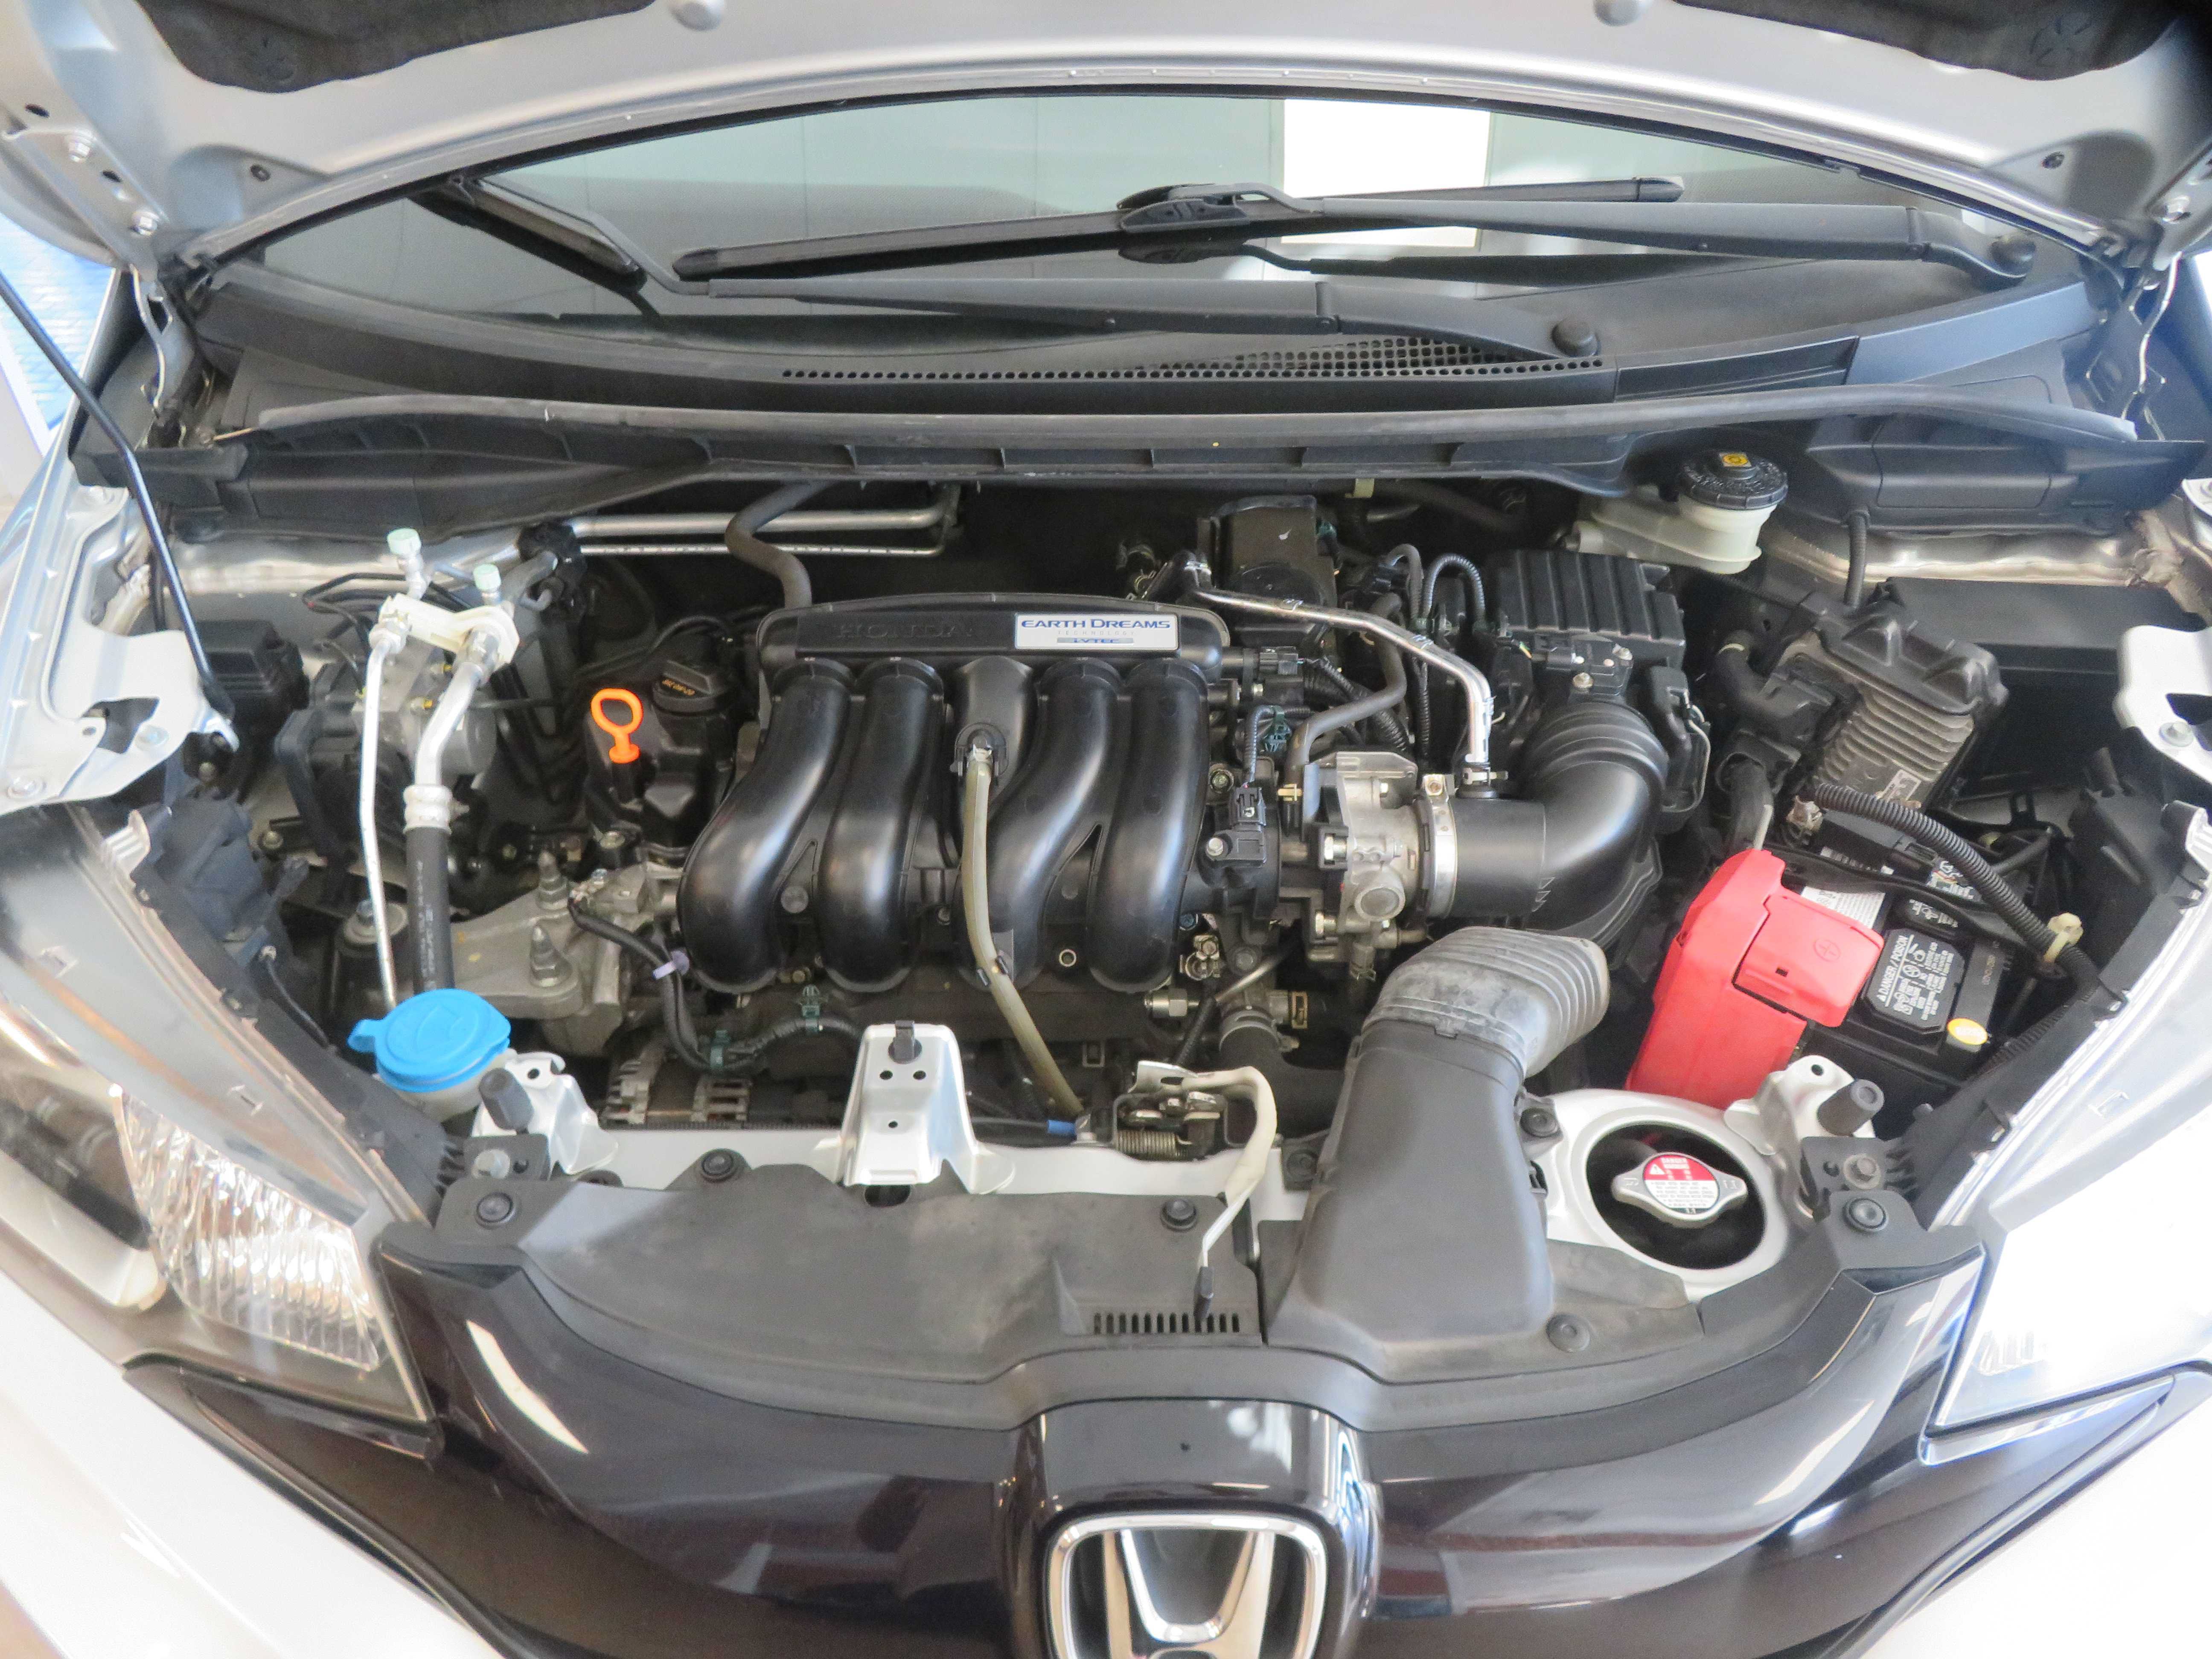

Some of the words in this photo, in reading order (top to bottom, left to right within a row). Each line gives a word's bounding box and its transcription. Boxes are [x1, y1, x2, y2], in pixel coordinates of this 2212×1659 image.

[1022, 620, 1086, 629] EARTH
[1091, 618, 1170, 629] DREAMS
[1878, 965, 1898, 995] DANGER
[1890, 935, 1909, 962] POISON
